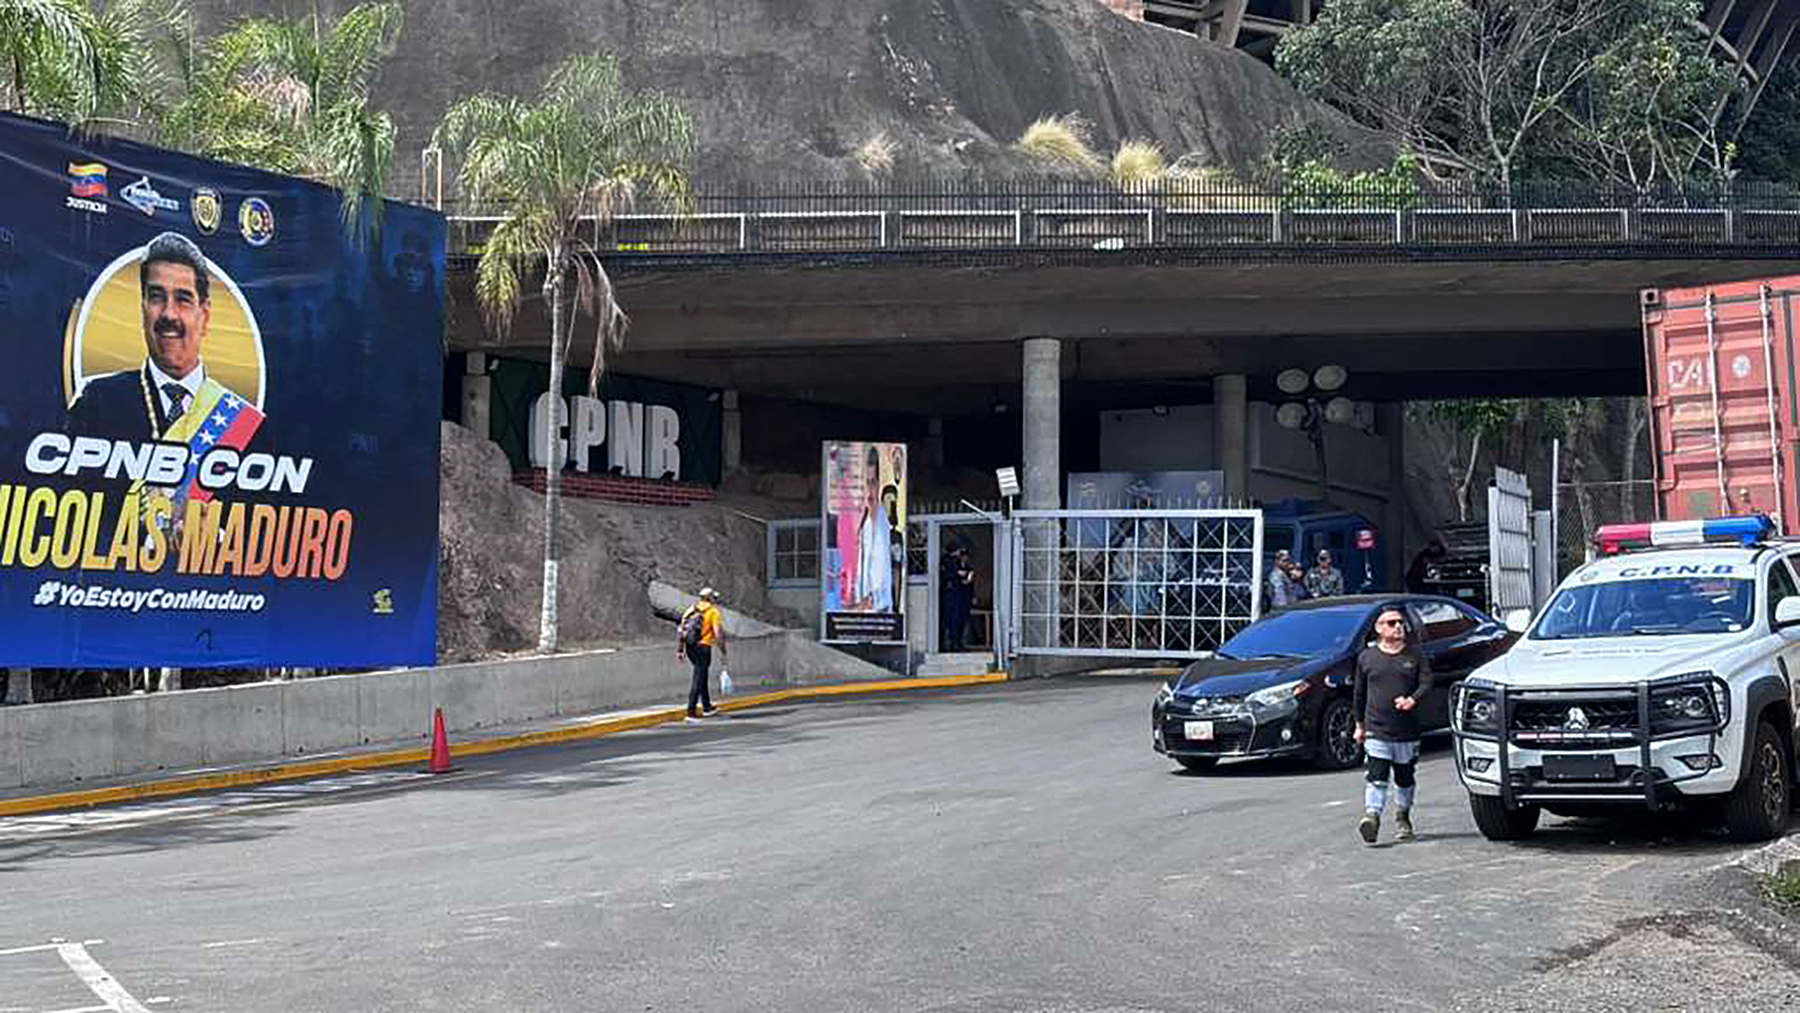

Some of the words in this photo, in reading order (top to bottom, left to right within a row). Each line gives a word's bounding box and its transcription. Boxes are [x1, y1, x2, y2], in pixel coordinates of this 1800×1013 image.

[25, 432, 189, 484] CPNB
[199, 449, 313, 493] CON
[529, 391, 681, 480] CPNB
[177, 499, 352, 580] MADURO
[34, 581, 265, 612] #YoEstoyConMaduro
